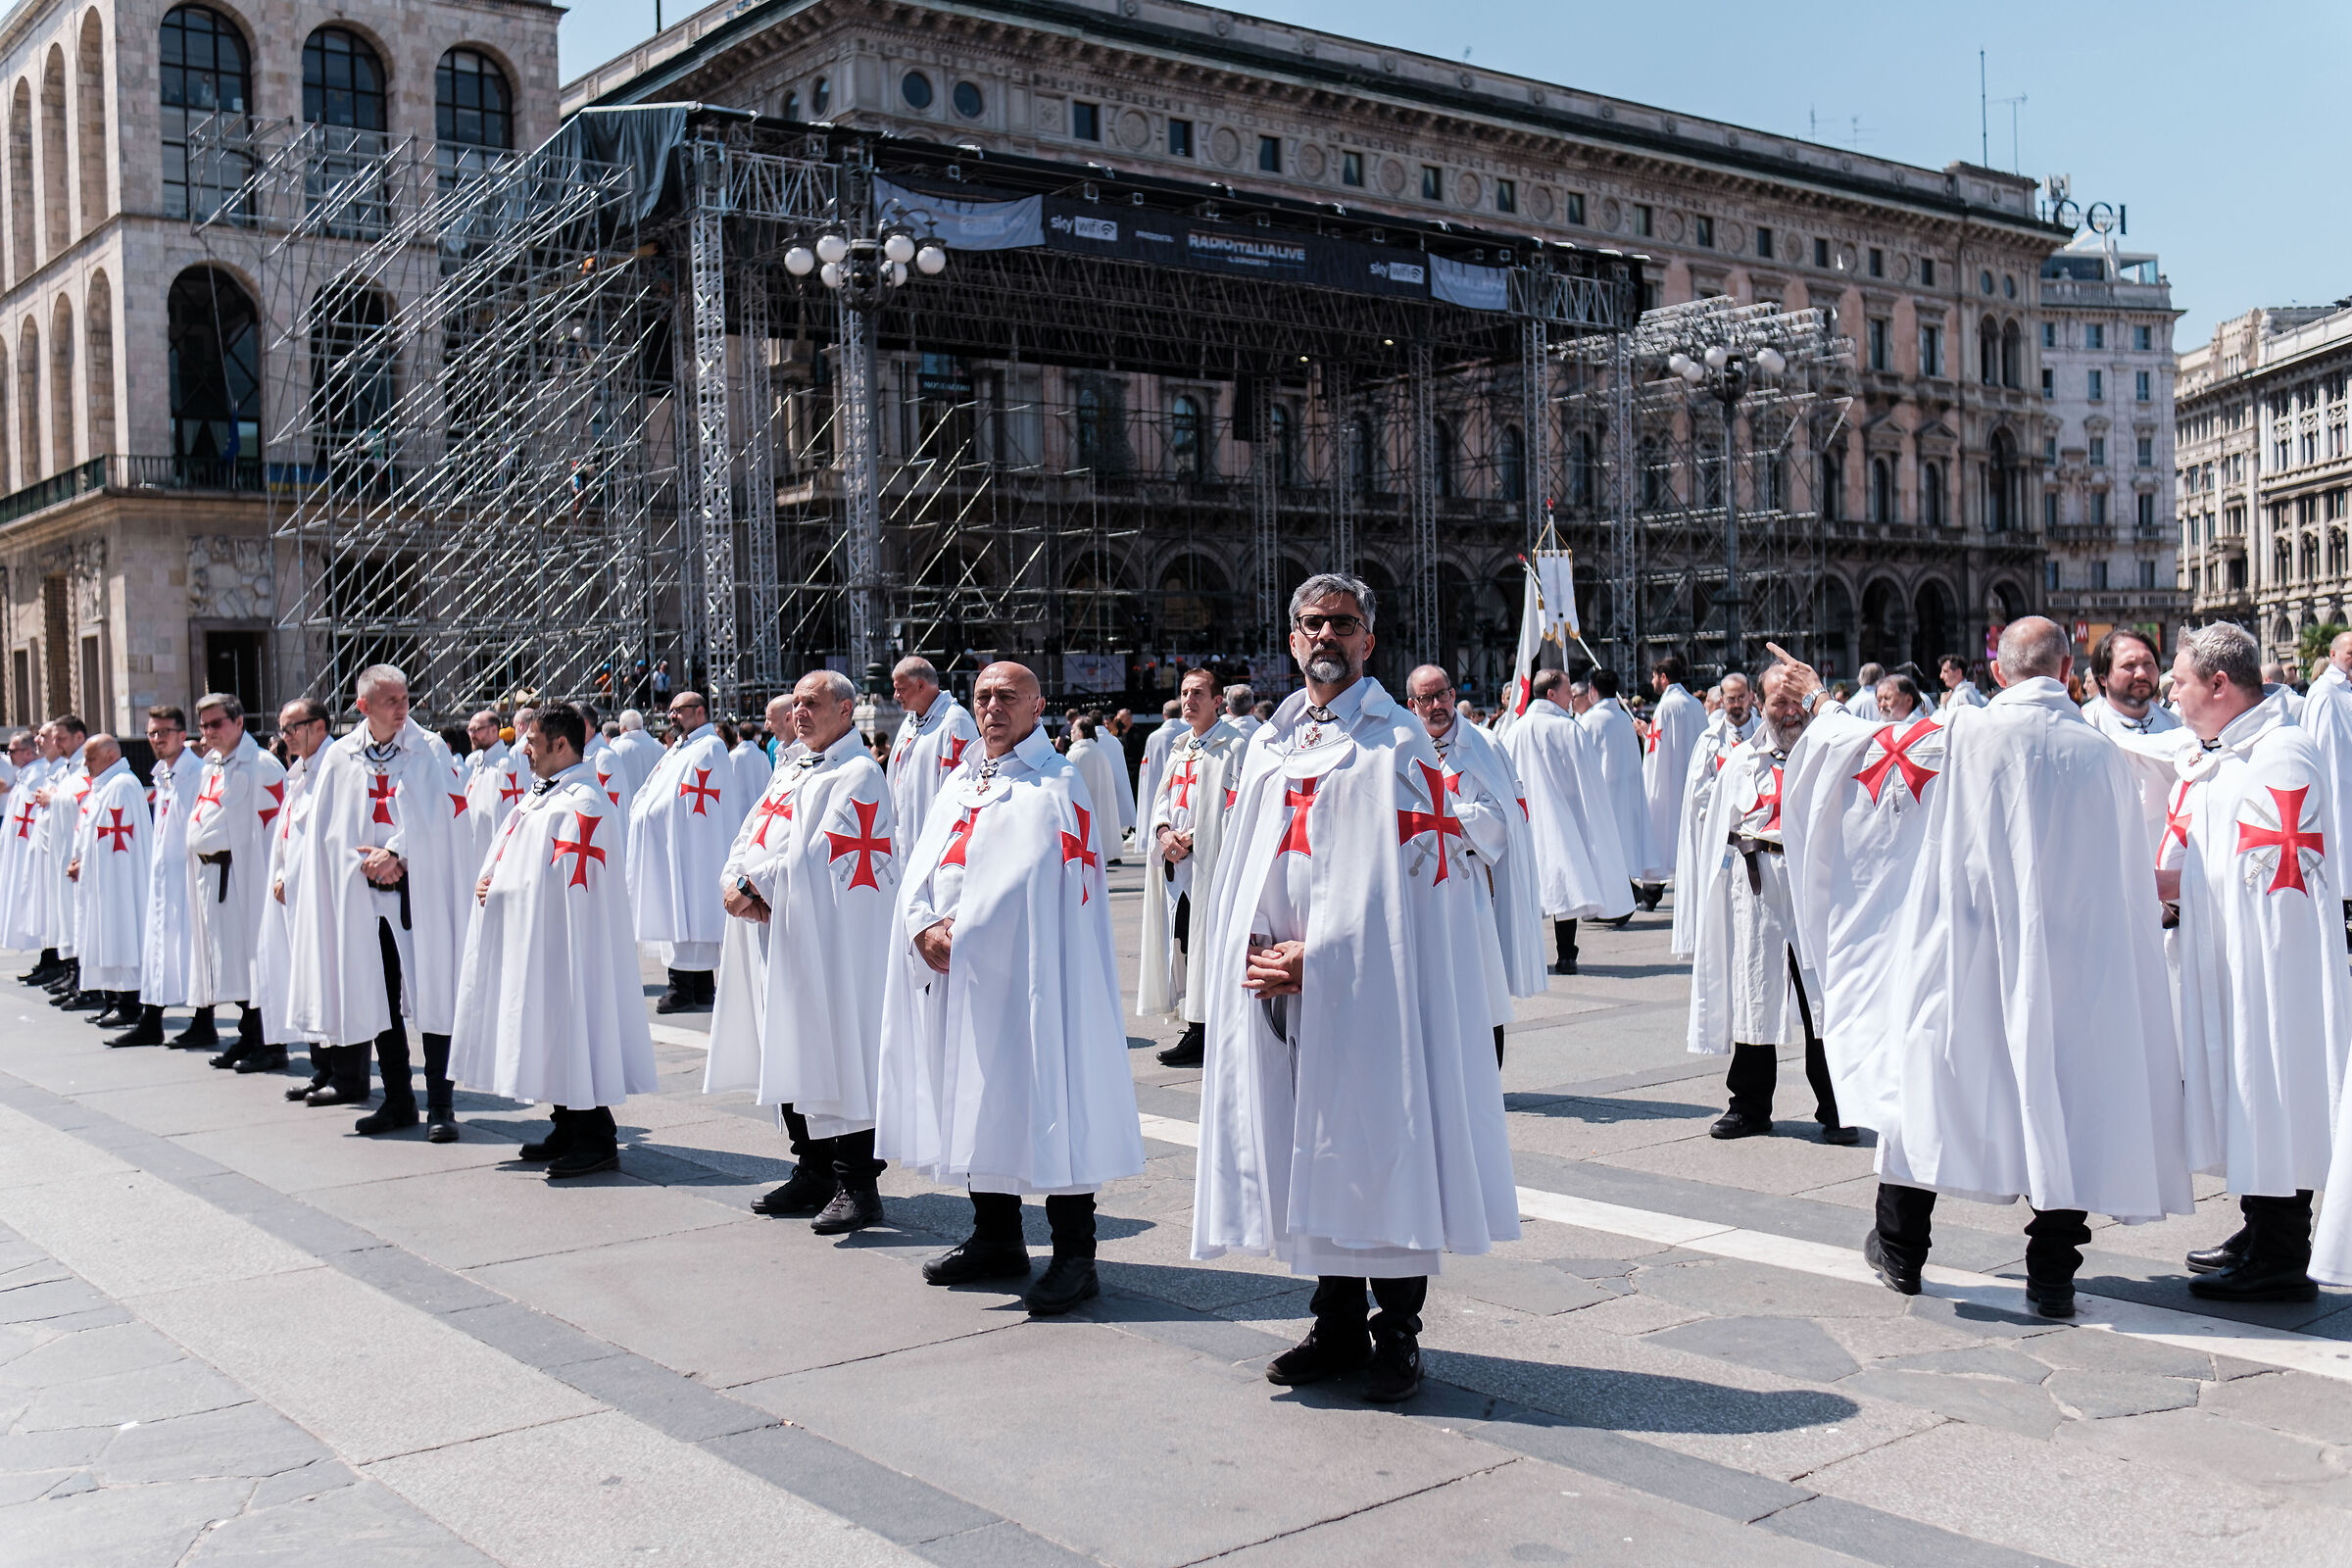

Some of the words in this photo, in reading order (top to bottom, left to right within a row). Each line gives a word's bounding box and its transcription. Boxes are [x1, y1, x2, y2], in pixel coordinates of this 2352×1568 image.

[1051, 215, 1074, 234] sky
[1079, 220, 1101, 234] wifi
[1370, 261, 1389, 278] sky
[2077, 624, 2087, 639] M
